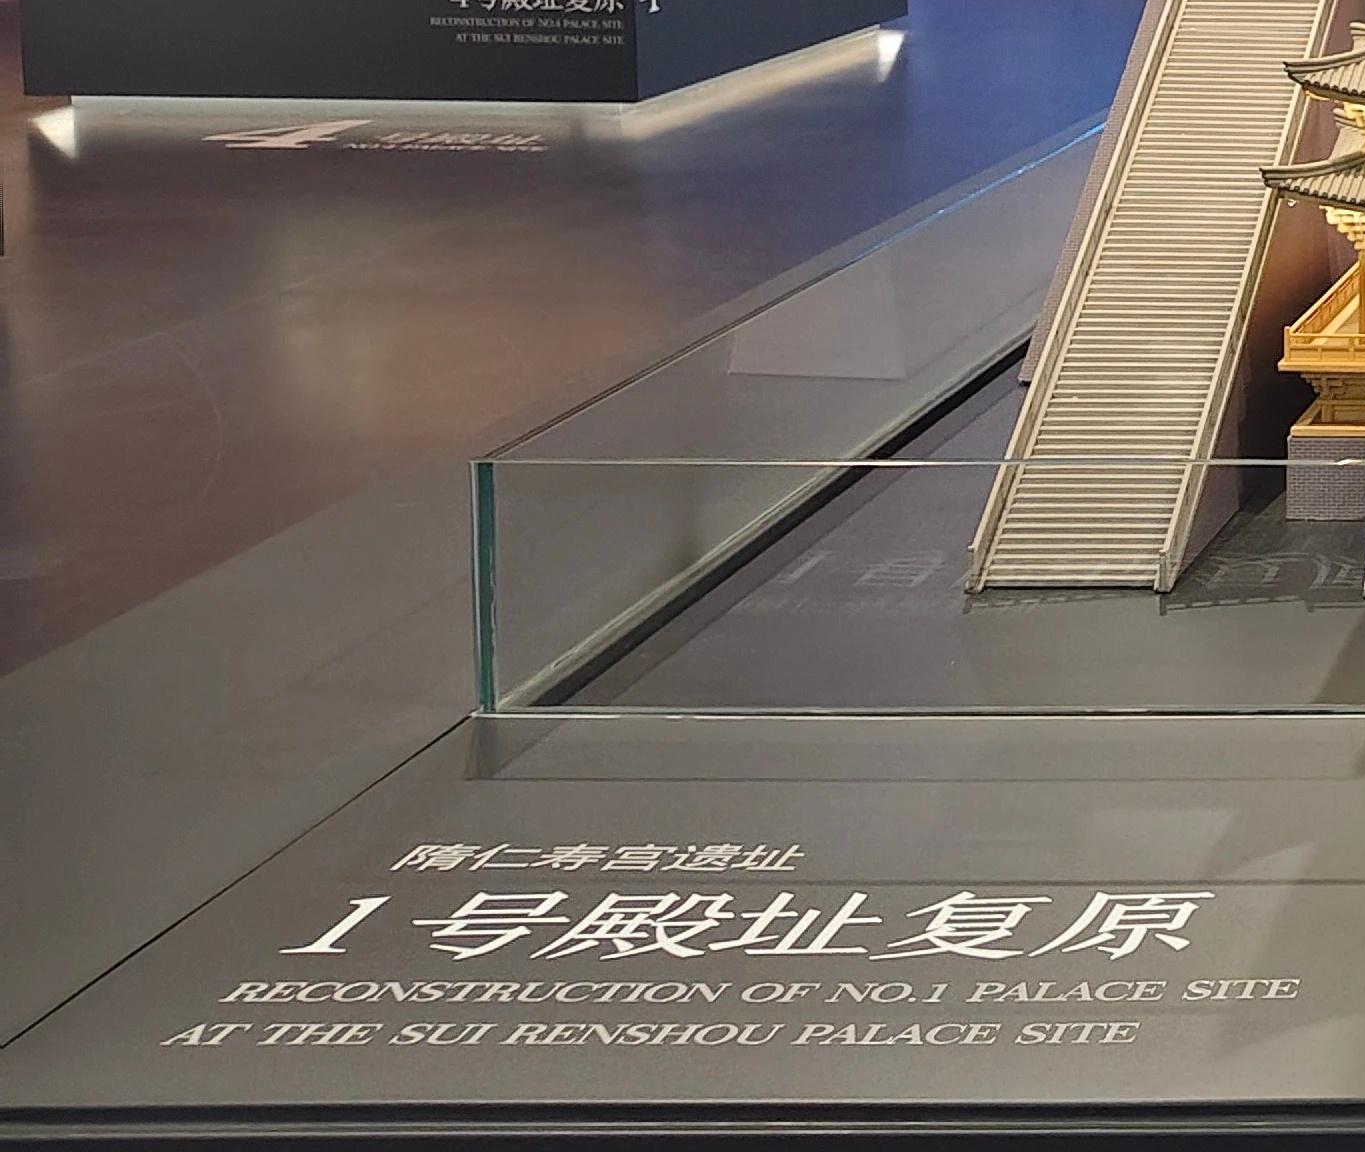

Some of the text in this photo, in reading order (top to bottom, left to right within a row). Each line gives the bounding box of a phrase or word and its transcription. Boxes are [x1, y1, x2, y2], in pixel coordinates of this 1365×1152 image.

[202, 119, 374, 149] 4
[391, 843, 805, 872] 隋仁寿宫遗址
[279, 890, 1215, 961] 1号殿址复原
[218, 978, 1301, 1004] RECONSTRUCTION OF NO.1 PALACE SITE
[160, 1021, 1141, 1047] AT THE SUI RENSHOU PALACE SITE
